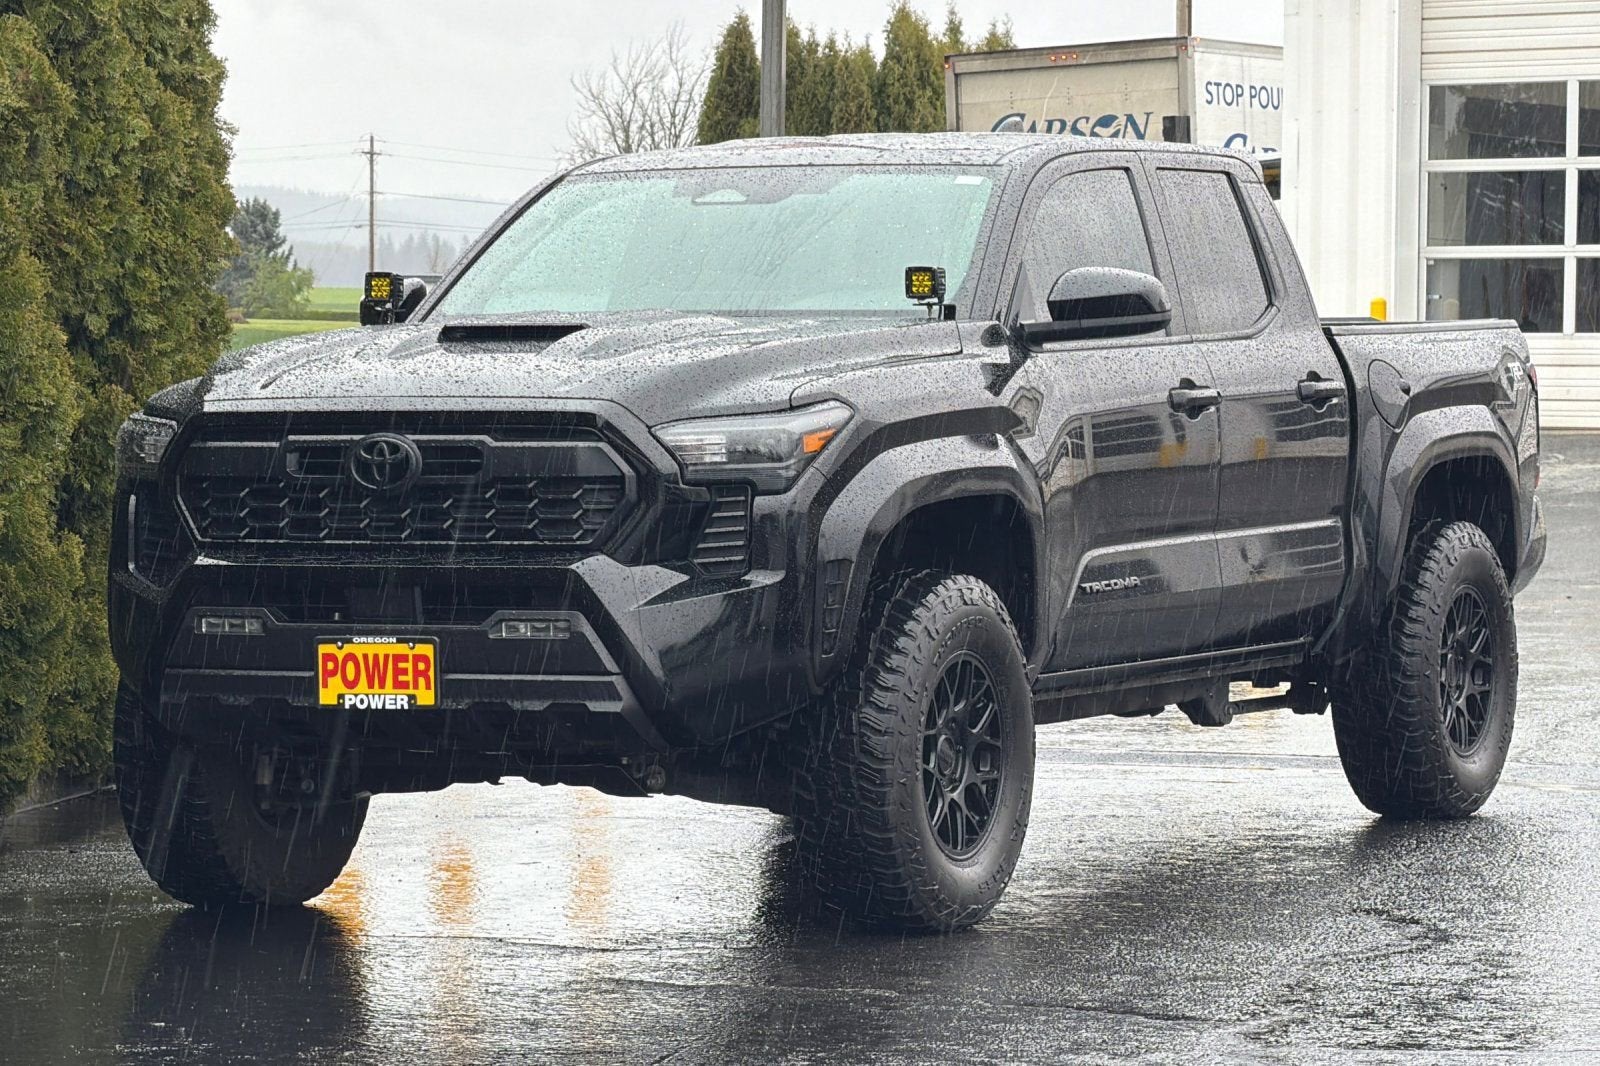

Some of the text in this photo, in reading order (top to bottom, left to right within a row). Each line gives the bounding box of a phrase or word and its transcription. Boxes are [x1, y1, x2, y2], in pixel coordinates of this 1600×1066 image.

[1205, 81, 1283, 110] STOP POU
[1080, 576, 1140, 593] TACOMA
[321, 652, 432, 690] POWER
[344, 694, 409, 709] POWER
